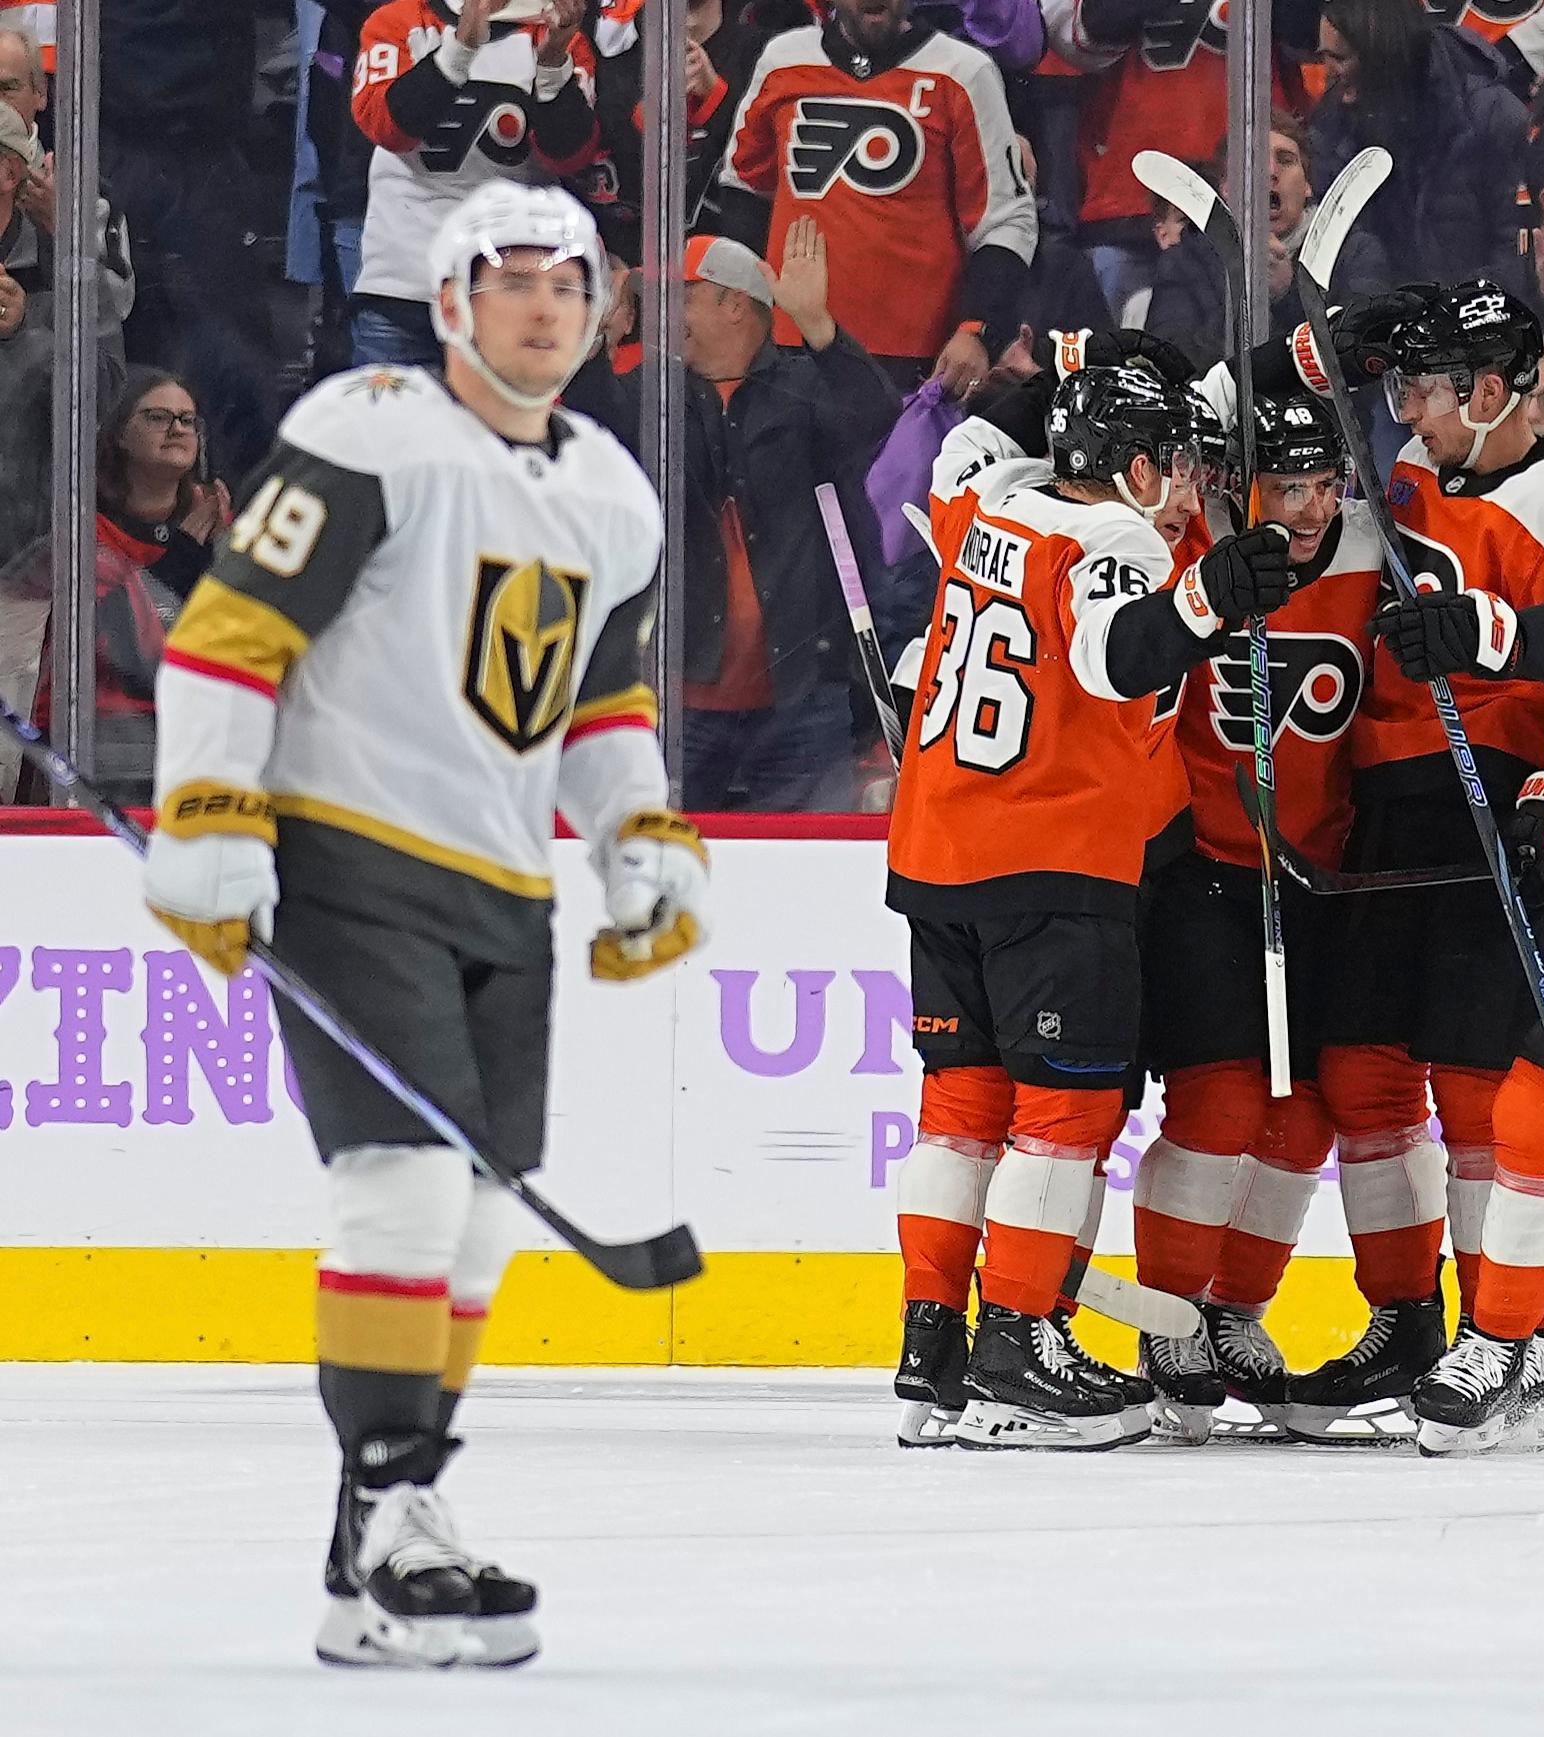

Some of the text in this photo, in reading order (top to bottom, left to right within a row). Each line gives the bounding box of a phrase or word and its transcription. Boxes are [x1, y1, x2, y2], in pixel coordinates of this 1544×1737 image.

[909, 77, 936, 118] C
[1050, 408, 1069, 433] 36
[1284, 407, 1313, 425] 48
[1087, 556, 1151, 600] 36
[919, 578, 1037, 774] 36
